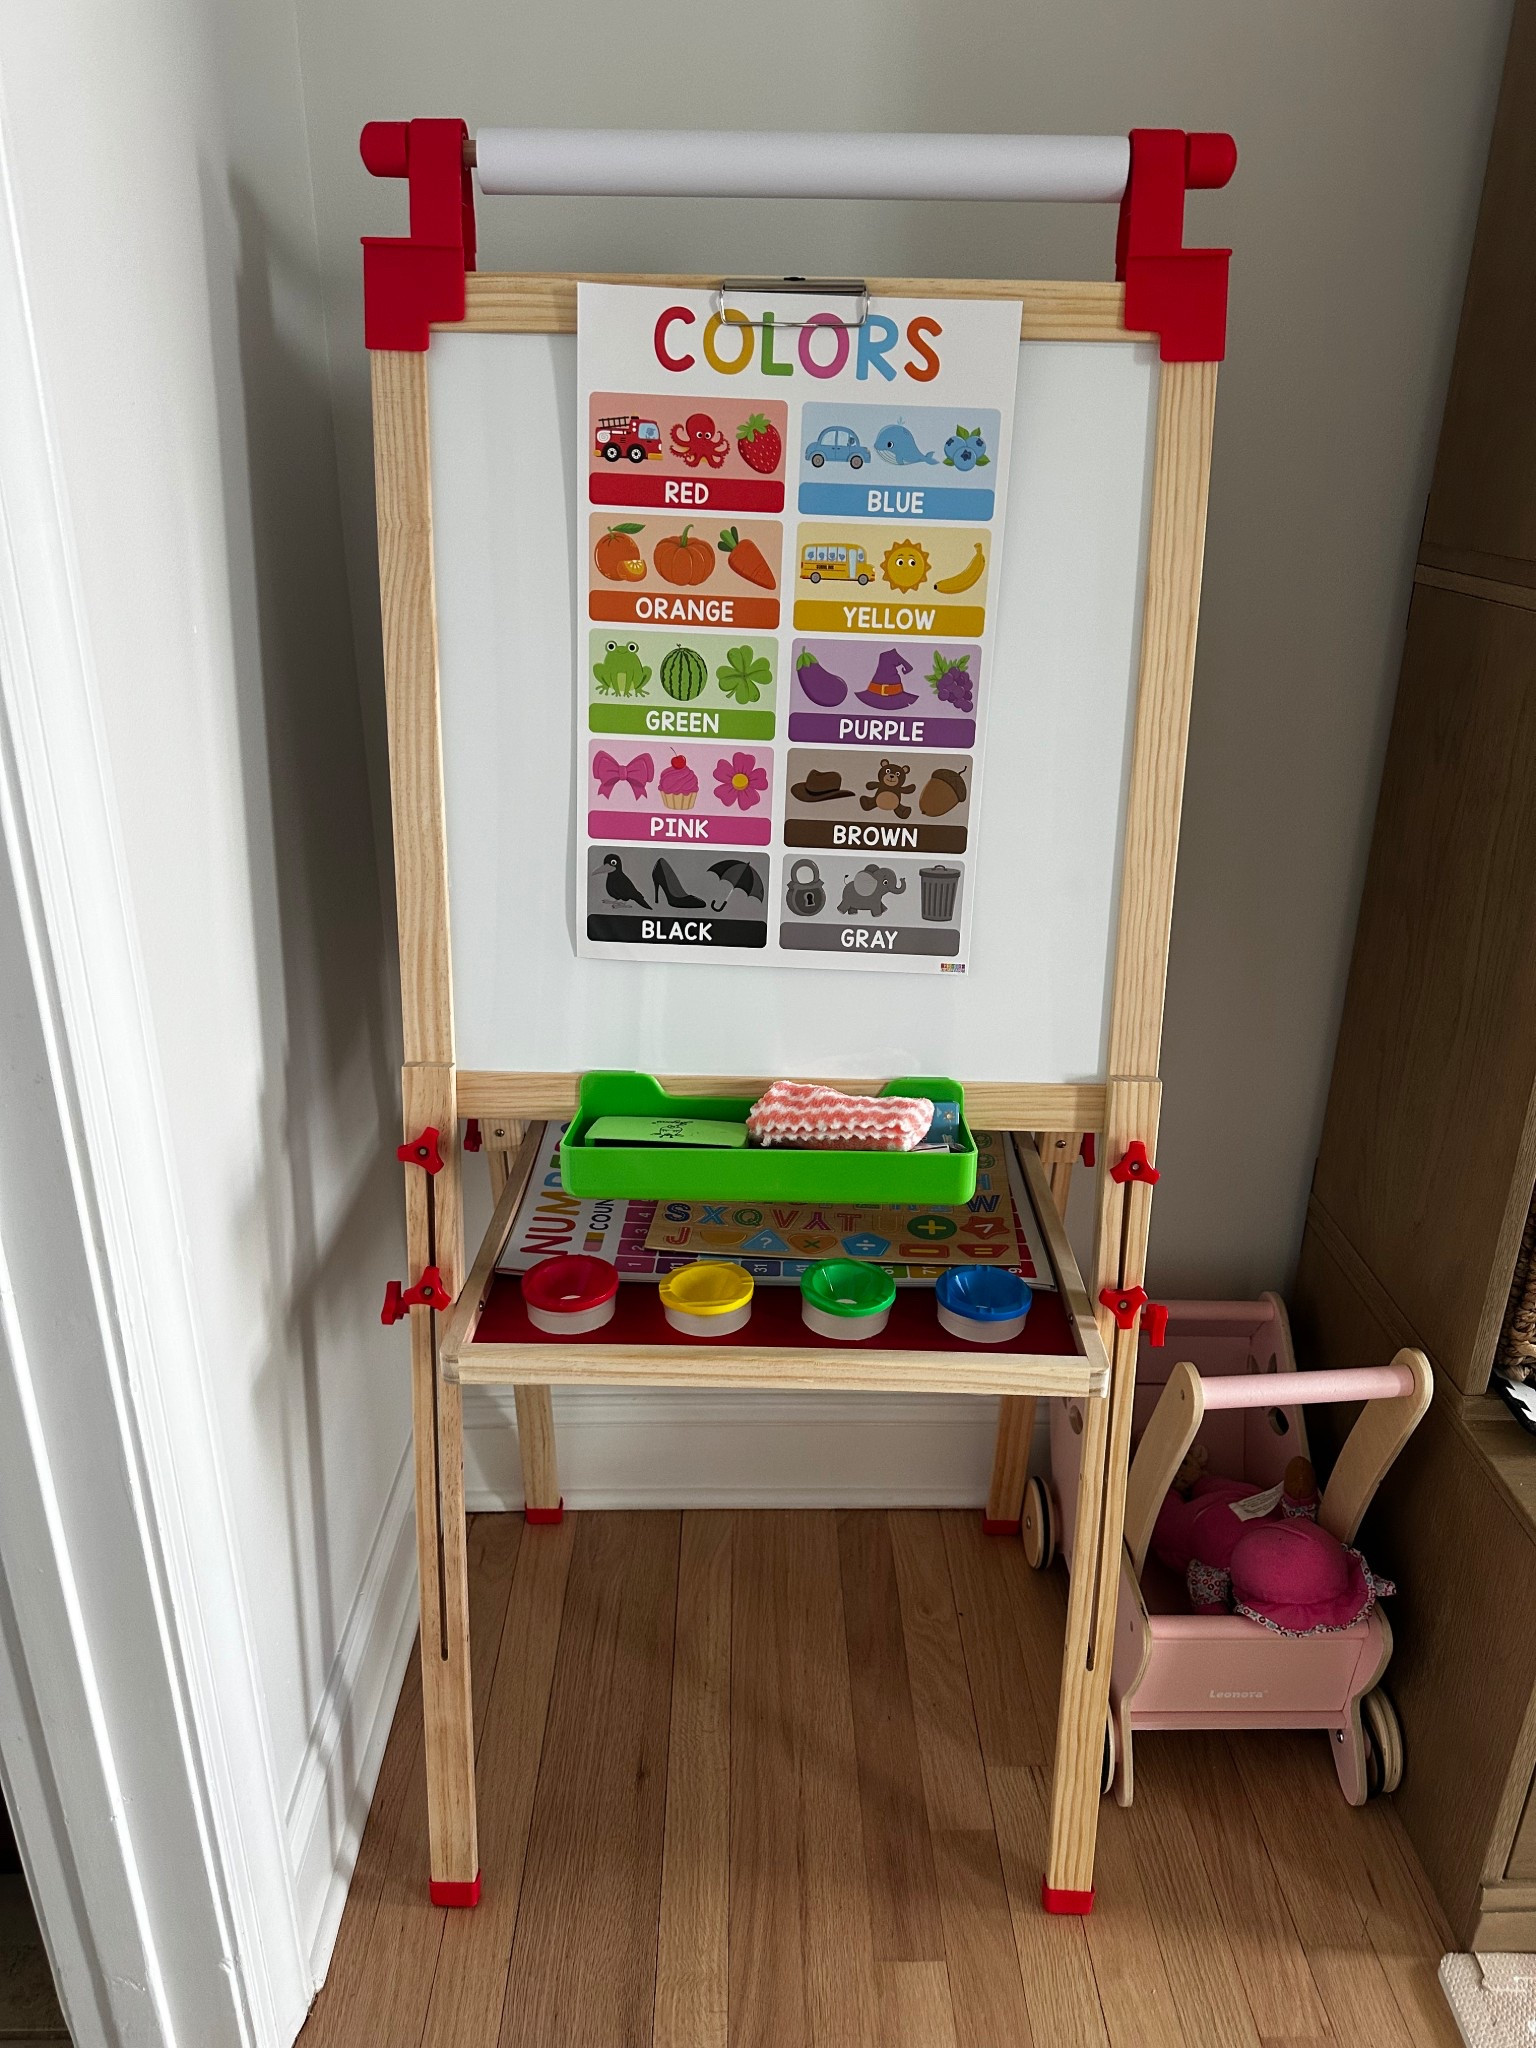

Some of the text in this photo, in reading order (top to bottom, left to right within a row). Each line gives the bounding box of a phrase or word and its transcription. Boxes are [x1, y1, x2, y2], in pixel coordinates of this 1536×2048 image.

[654, 306, 943, 382] COLORS
[665, 481, 709, 504] RED
[867, 490, 924, 514] BLUE
[635, 597, 734, 623] ORANGE
[843, 607, 935, 631] YELLOW
[646, 711, 719, 733] GREEN
[840, 719, 924, 741] PURPLE
[650, 817, 709, 838] PINK
[833, 825, 918, 848] BROWN
[642, 920, 712, 941] BLACK
[840, 928, 898, 950] GRAY
